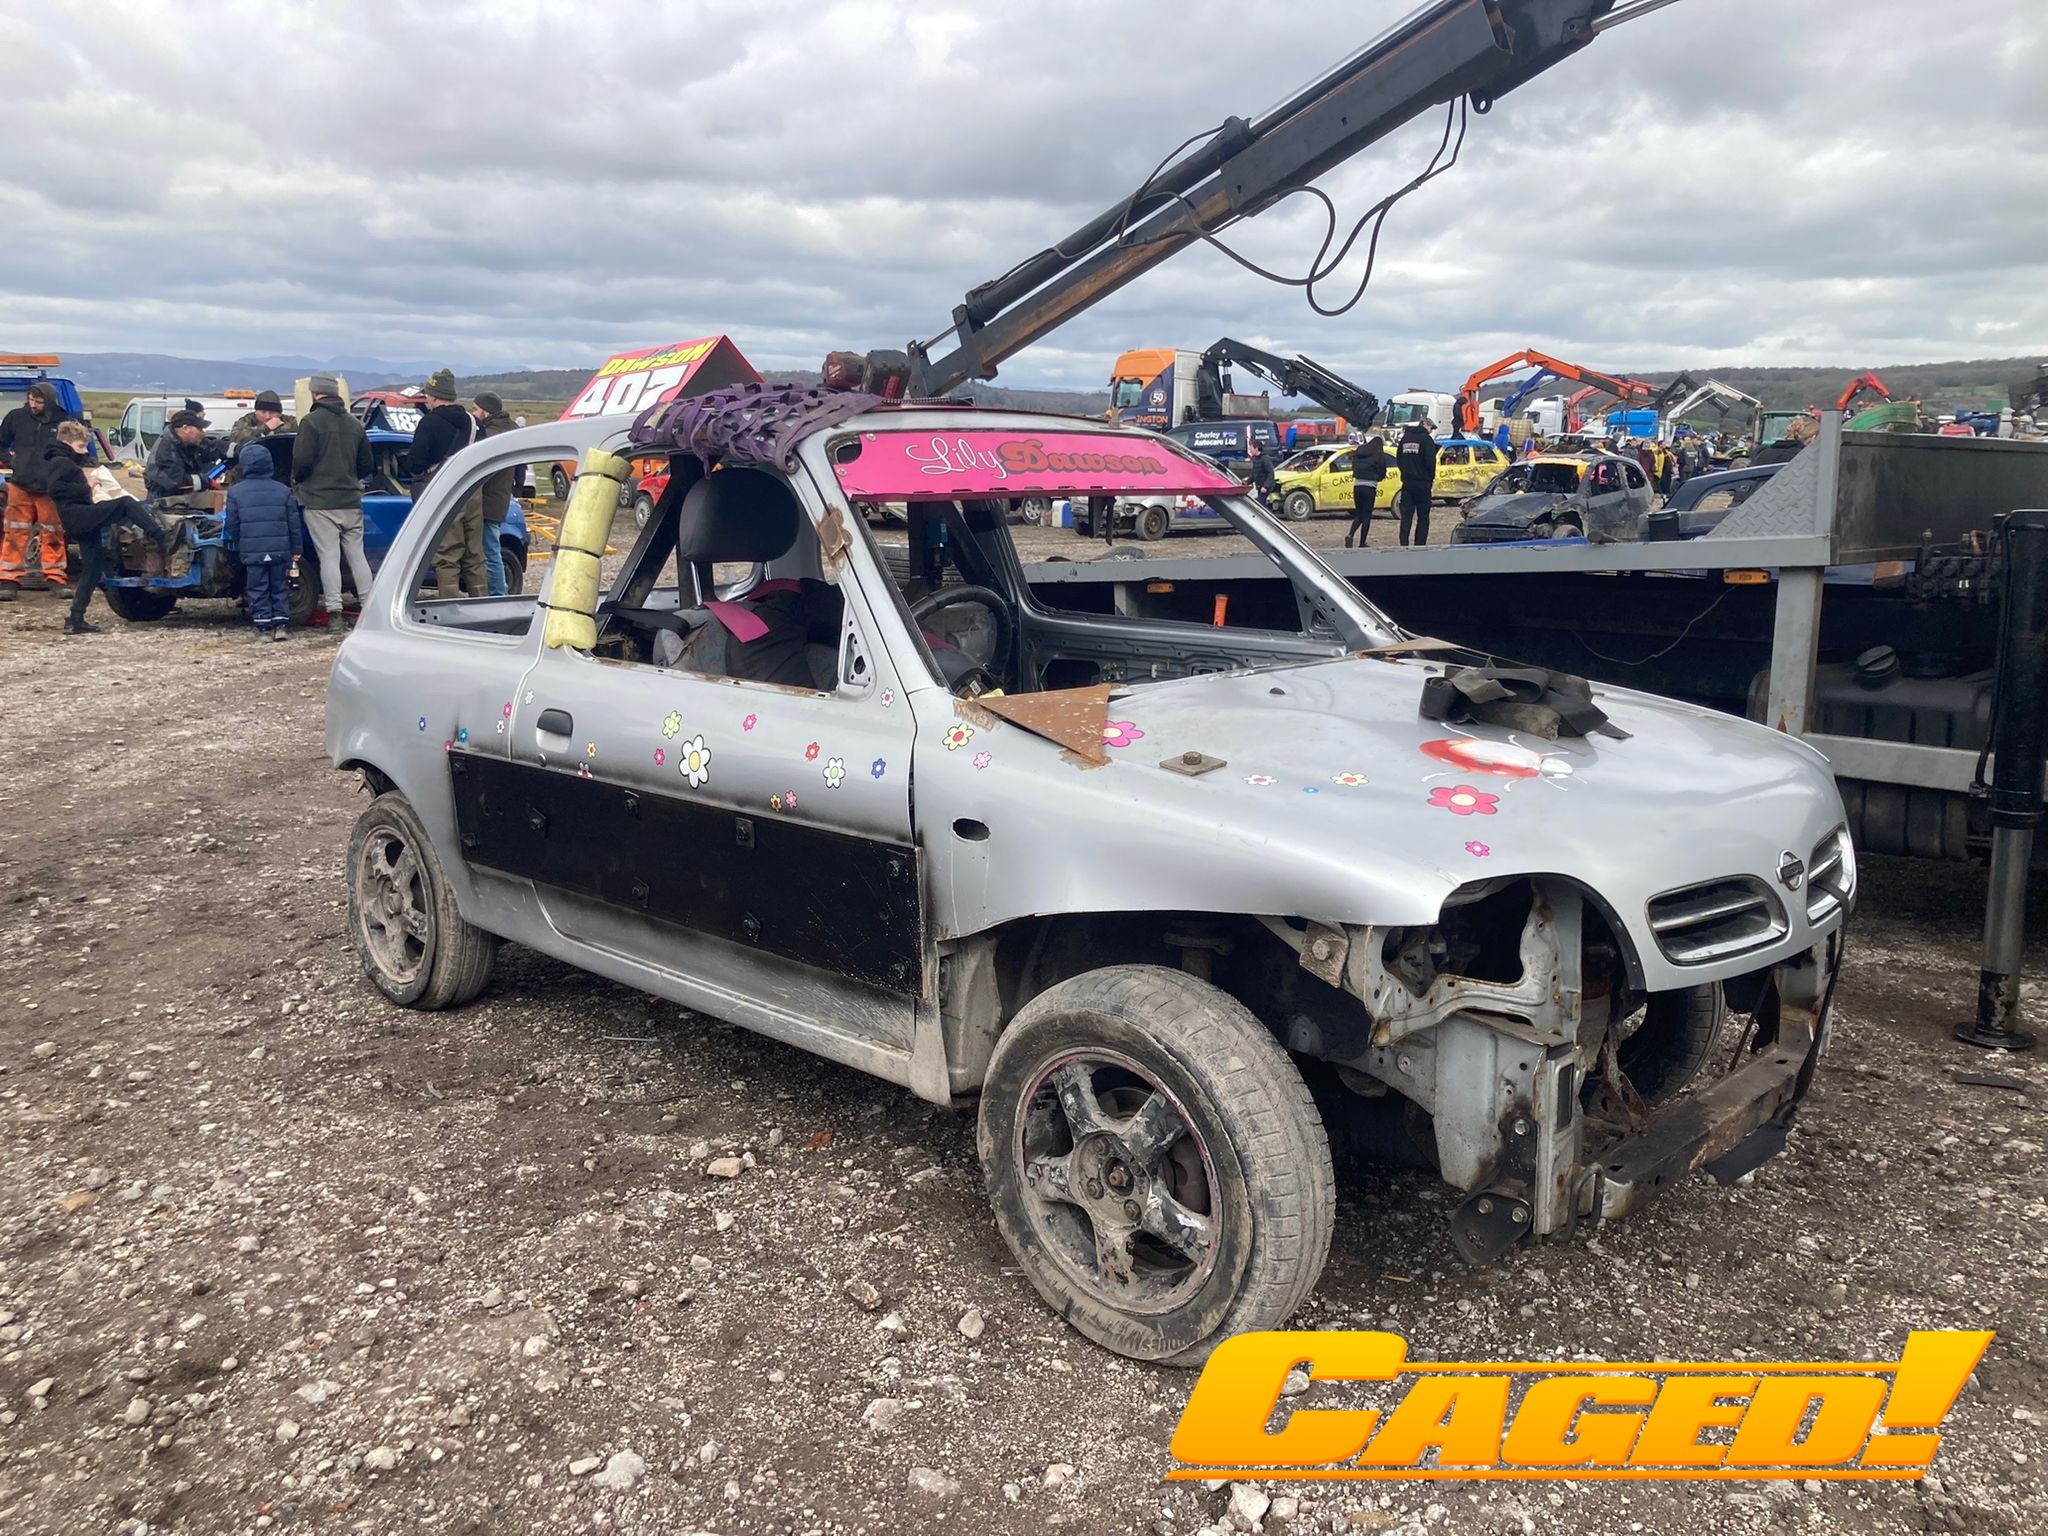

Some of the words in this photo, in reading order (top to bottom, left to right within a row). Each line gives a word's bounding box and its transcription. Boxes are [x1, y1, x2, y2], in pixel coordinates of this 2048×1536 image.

[596, 338, 718, 377] DAWSON
[569, 364, 690, 417] 407
[1195, 431, 1221, 439] Chorley
[905, 437, 1008, 479] Lily
[996, 439, 1168, 475] Dawson
[1332, 474, 1354, 487] CARS
